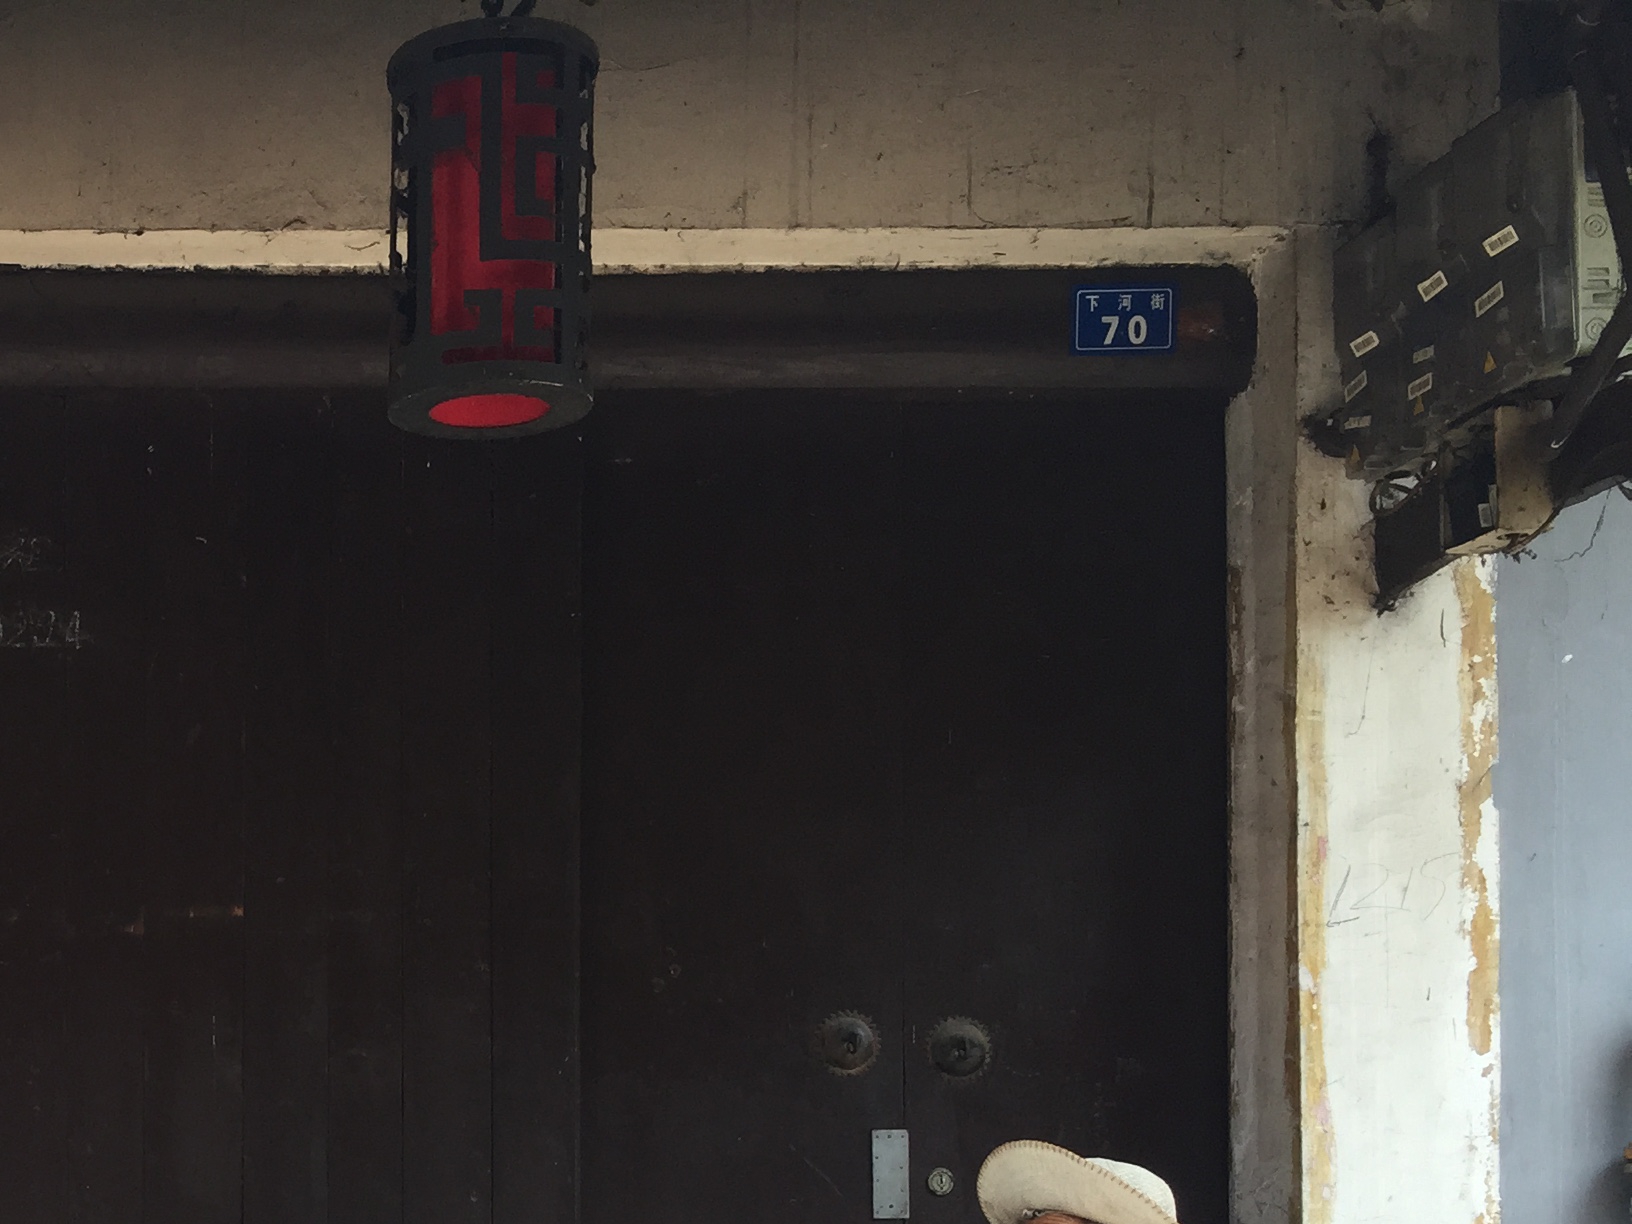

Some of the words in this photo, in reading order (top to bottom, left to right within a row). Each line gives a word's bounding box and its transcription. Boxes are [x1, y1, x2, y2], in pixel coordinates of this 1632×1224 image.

[1085, 293, 1165, 312] 下河街
[1101, 315, 1148, 346] 70
